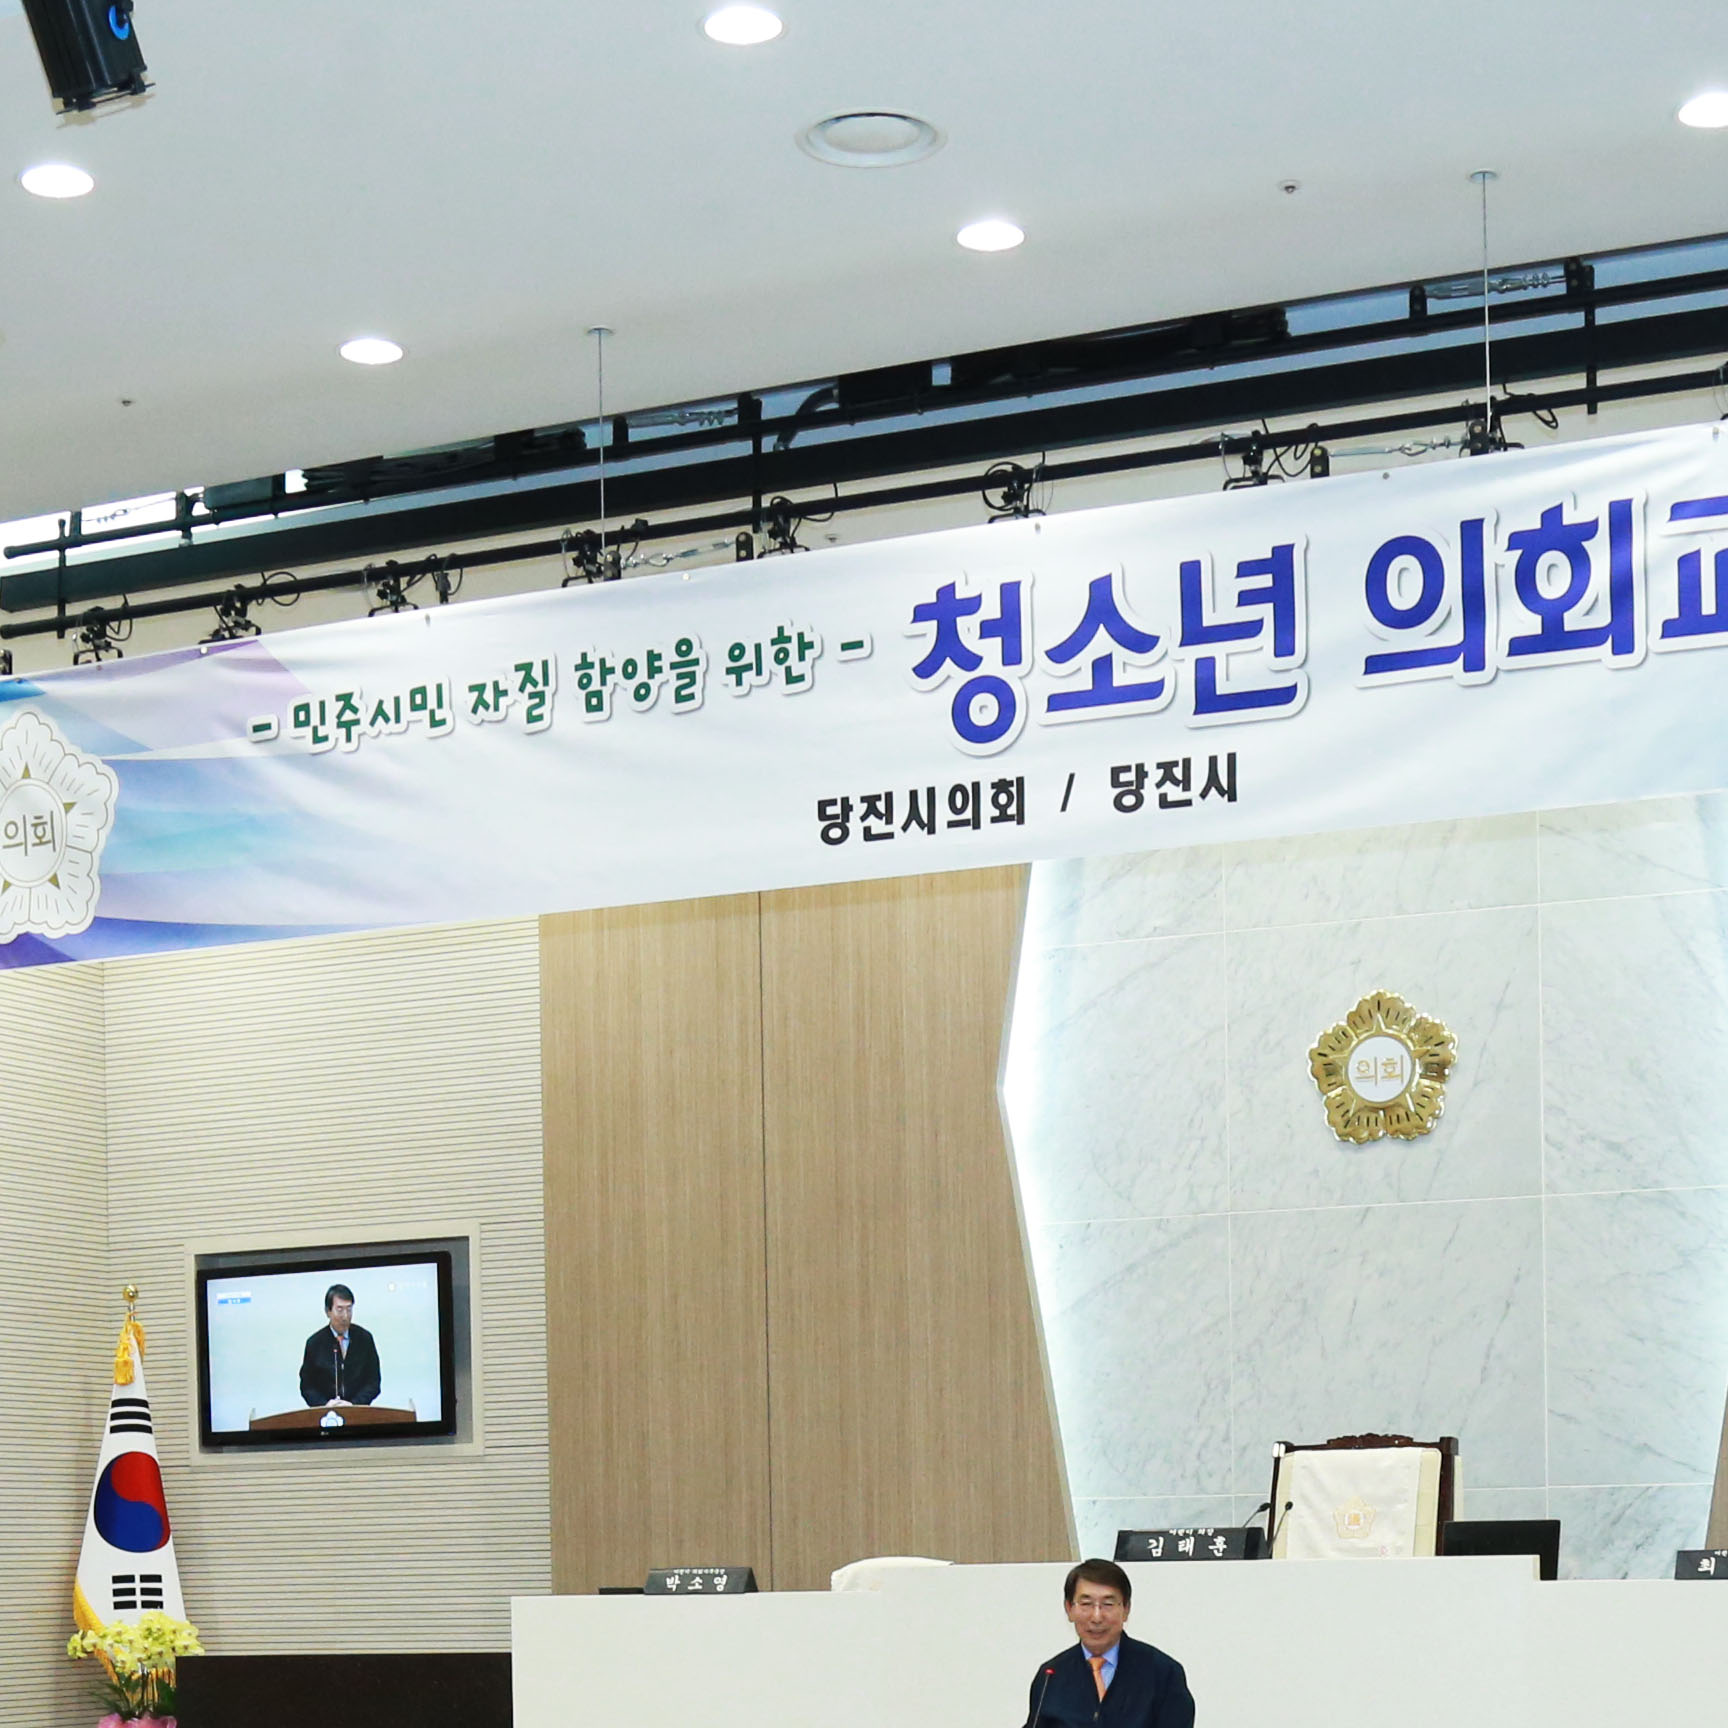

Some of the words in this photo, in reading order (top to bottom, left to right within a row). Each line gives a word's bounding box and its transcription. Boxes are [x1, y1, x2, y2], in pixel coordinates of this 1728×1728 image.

[292, 684, 447, 746] 민주시민
[467, 660, 553, 723] 자질
[573, 636, 705, 714] 함양을
[725, 624, 816, 686] 위한
[910, 541, 1298, 745] 청소년
[1, 810, 57, 857] 의회
[816, 775, 1028, 846] 당진시의회
[1110, 752, 1239, 813] 당진시
[1354, 1053, 1405, 1088] 의회
